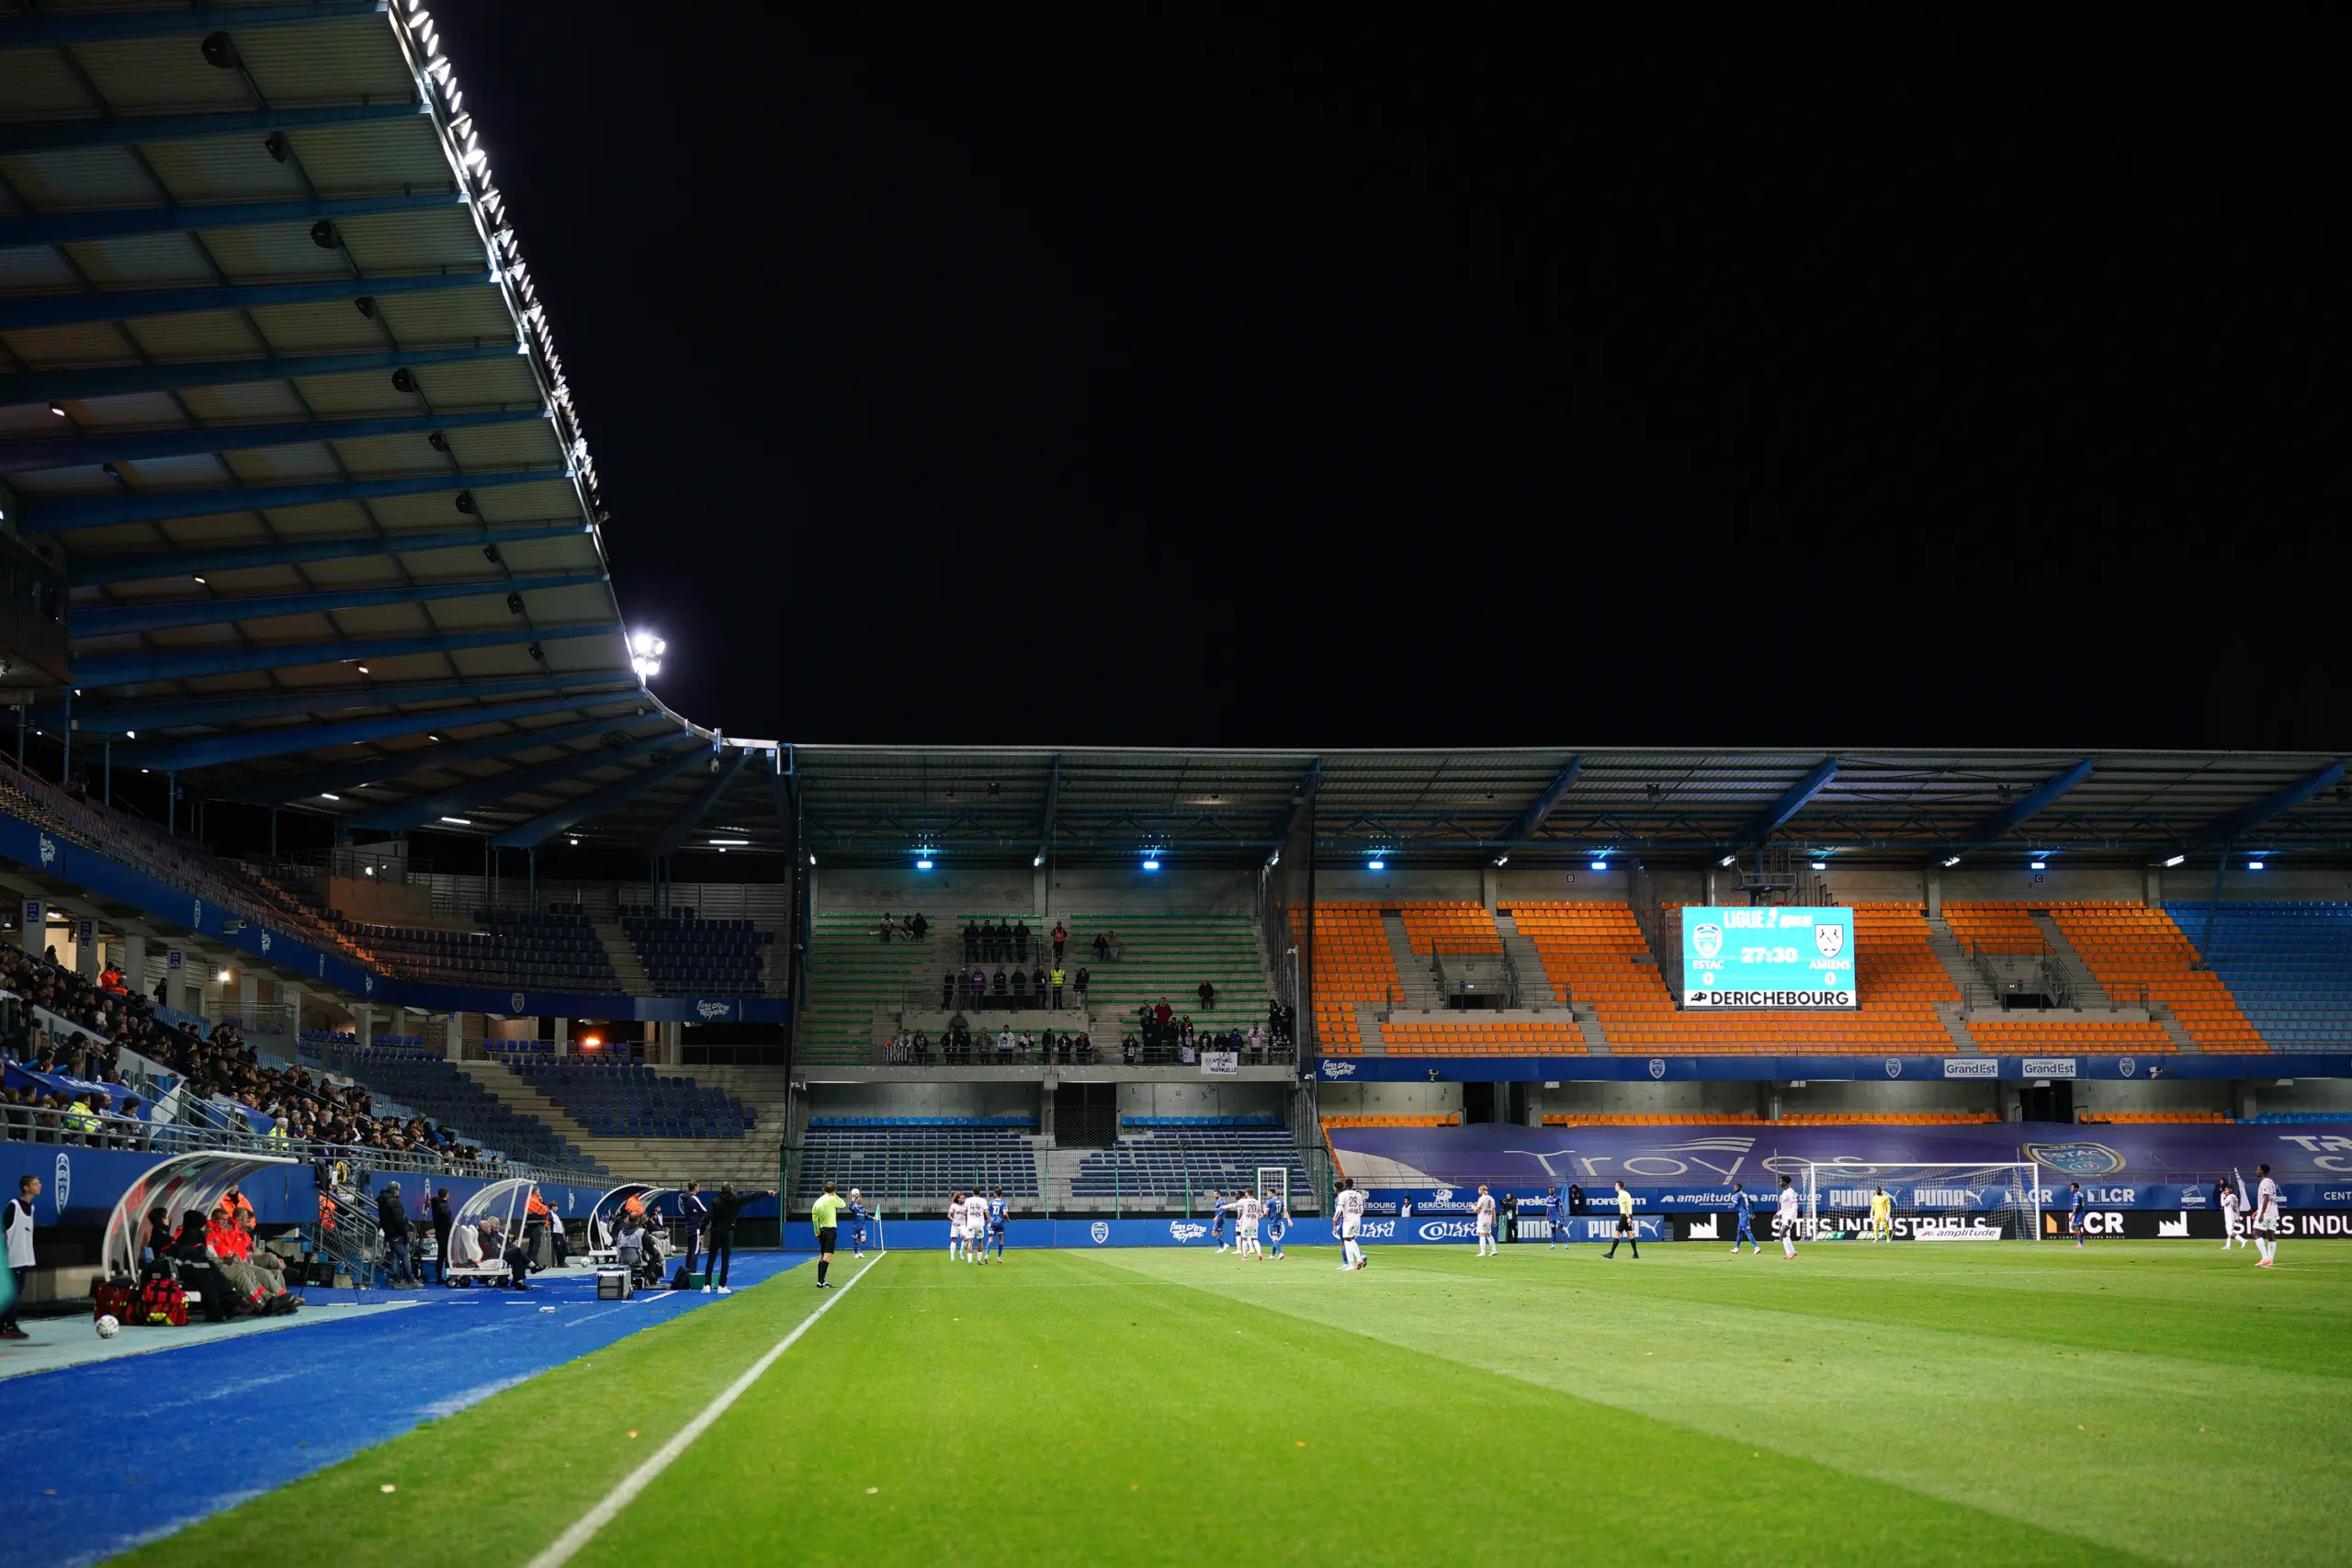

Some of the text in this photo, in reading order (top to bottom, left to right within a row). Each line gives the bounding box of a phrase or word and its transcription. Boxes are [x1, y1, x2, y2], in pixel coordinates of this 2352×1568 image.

[1723, 909, 1764, 929] LIGUE
[1766, 908, 1778, 928] 2
[1741, 947, 1798, 964] 27:30
[1692, 960, 1724, 970] ESTAC
[1809, 960, 1852, 970] AMIENS
[1702, 972, 1714, 986] 0
[1825, 972, 1837, 986] 0
[1711, 991, 1849, 1006] DERICHEBOURG
[2040, 1150, 2100, 1158] ESTAC
[1517, 1195, 1547, 1206] orele
[1586, 1197, 1646, 1206] norem
[1760, 1192, 1822, 1202] amtude
[1915, 1190, 1964, 1206] PUMA
[2101, 1188, 2135, 1202] LCR
[969, 1202, 980, 1211] 44
[1248, 1203, 1257, 1213] 20
[1518, 1221, 1552, 1238] UMA
[1771, 1218, 1832, 1236] STES
[2233, 1215, 2295, 1235] SIES
[1937, 1229, 1996, 1237] amplitude
